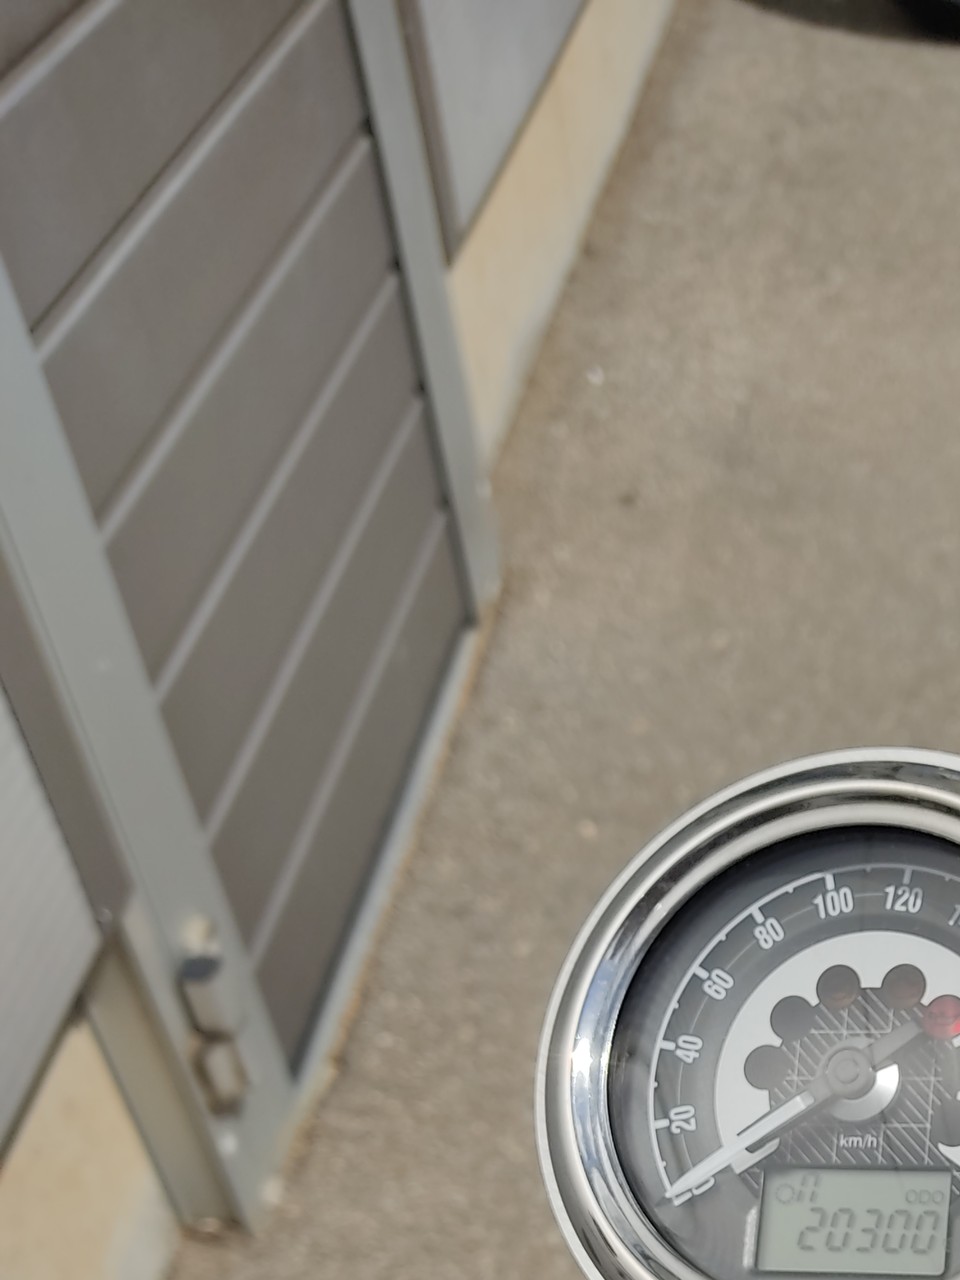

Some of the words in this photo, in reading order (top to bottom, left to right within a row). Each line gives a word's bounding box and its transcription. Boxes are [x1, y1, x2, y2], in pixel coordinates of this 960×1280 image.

[812, 886, 854, 919] 100
[884, 886, 923, 913] 120
[754, 917, 785, 950] 80
[703, 968, 734, 1000] 60
[675, 1034, 703, 1064] 40
[669, 1104, 697, 1134] 20
[839, 1134, 877, 1149] km/h
[905, 1189, 944, 1205] ODO
[797, 1206, 940, 1254] 20300
